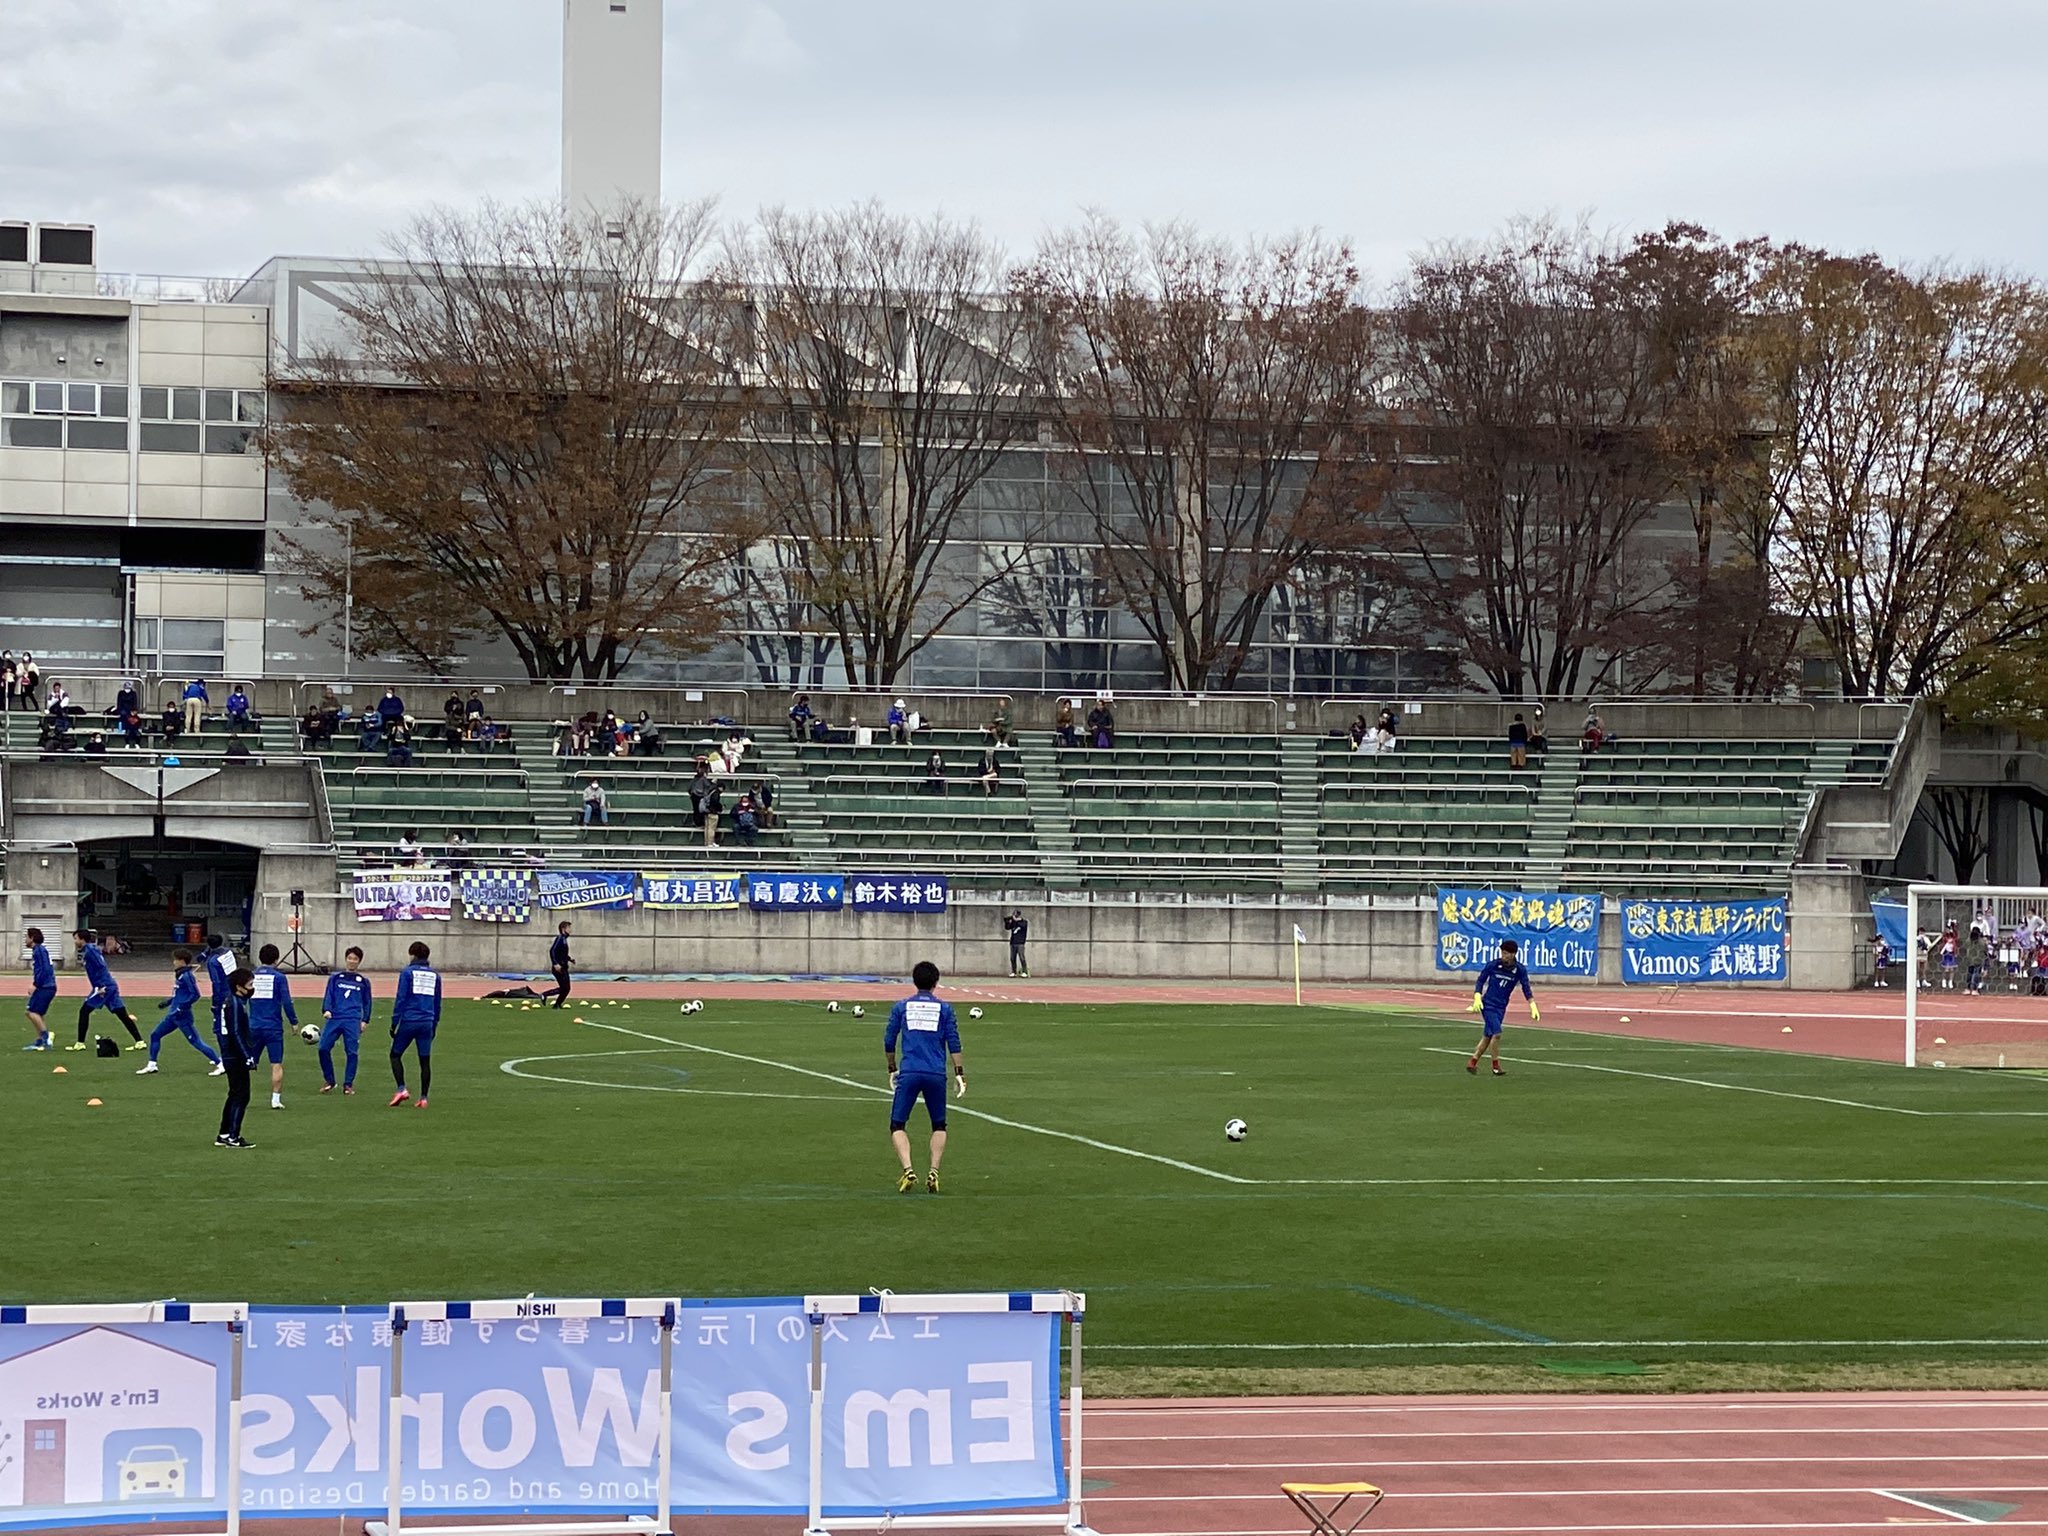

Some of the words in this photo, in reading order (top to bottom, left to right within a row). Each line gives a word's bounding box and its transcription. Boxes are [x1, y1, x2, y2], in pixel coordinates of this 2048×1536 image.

[355, 886, 397, 903] ULTRA
[415, 886, 451, 902] SATO
[540, 885, 625, 907] MUSASHINO
[648, 880, 735, 902] 都丸昌弘
[753, 881, 823, 903] 高慶汰
[854, 881, 945, 904] 鈴木裕也
[1655, 905, 1783, 936] 東京武蔵野シティFC
[1472, 937, 1503, 964] Prid
[1516, 939, 1531, 966] of
[1535, 939, 1557, 967] the
[1562, 940, 1595, 975] City
[1626, 947, 1700, 976] Vamos
[1709, 943, 1781, 976] 武蔵野
[516, 1303, 556, 1316] NISHI
